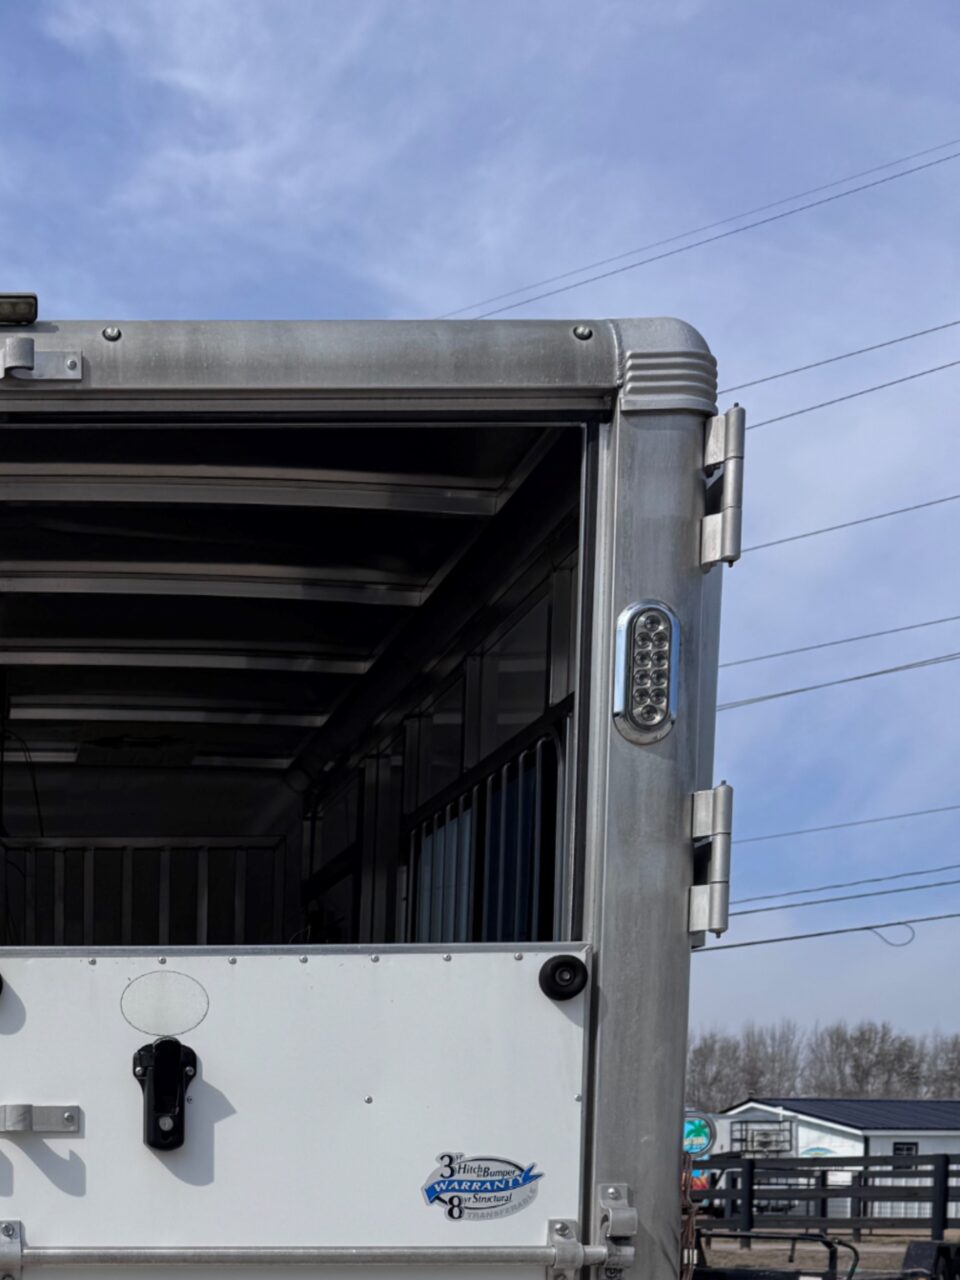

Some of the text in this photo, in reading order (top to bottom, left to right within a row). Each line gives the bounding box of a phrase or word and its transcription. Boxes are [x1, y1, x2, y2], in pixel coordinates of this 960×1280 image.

[440, 1154, 455, 1179] 3
[457, 1163, 483, 1175] Hitch
[482, 1166, 516, 1178] Bumper
[434, 1174, 523, 1192] WARRANTY
[447, 1195, 463, 1219] 8
[472, 1193, 512, 1203] Structural
